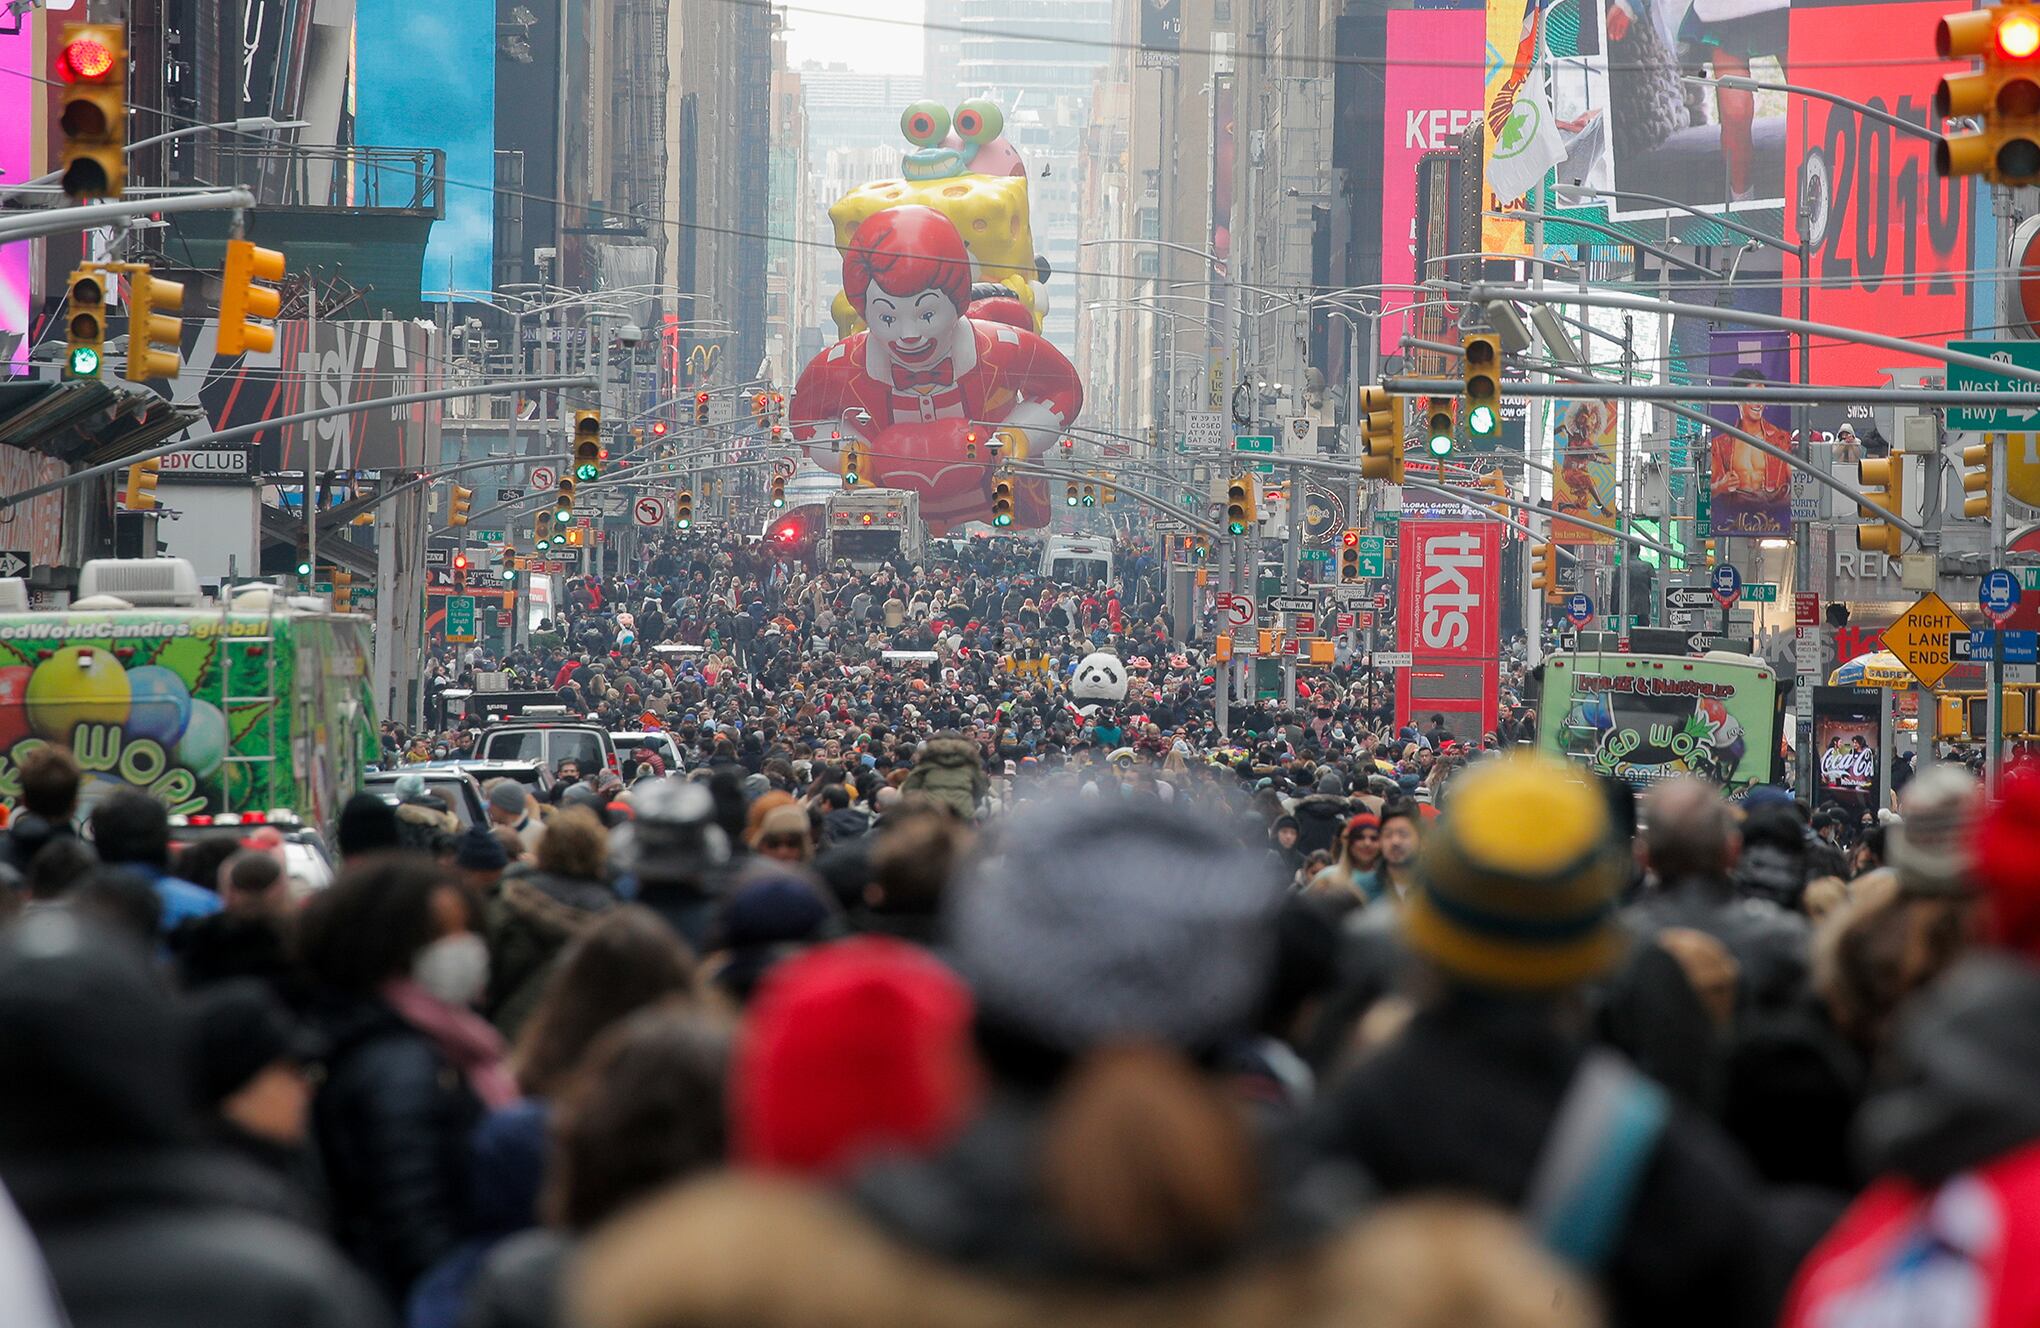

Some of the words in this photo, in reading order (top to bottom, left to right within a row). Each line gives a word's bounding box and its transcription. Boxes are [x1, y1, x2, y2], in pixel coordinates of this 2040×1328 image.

[1960, 380, 2000, 392] West
[2008, 379, 2040, 392] Side
[1848, 405, 1868, 418] SWISS
[1962, 407, 1997, 423] Hwy
[1250, 440, 1260, 448] TO
[1717, 512, 1781, 532] Aladdin
[487, 531, 496, 540] 45
[1302, 551, 1308, 559] W
[1312, 551, 1320, 559] 45
[2026, 570, 2037, 587] W
[1422, 531, 1483, 648] tkts
[1741, 587, 1749, 600] W
[1752, 586, 1765, 600] 48
[1675, 593, 1694, 602] ONE
[1414, 595, 1422, 632] Development
[1610, 618, 1617, 629] W
[1908, 614, 1953, 628] RIGHT
[1797, 627, 1803, 638] 3
[1971, 632, 1985, 643] M7
[1693, 637, 1711, 647] ONE
[1908, 633, 1949, 647] LANE
[1909, 651, 1949, 665] ENDS
[1971, 648, 1993, 660] M104
[1798, 676, 1803, 686] 6
